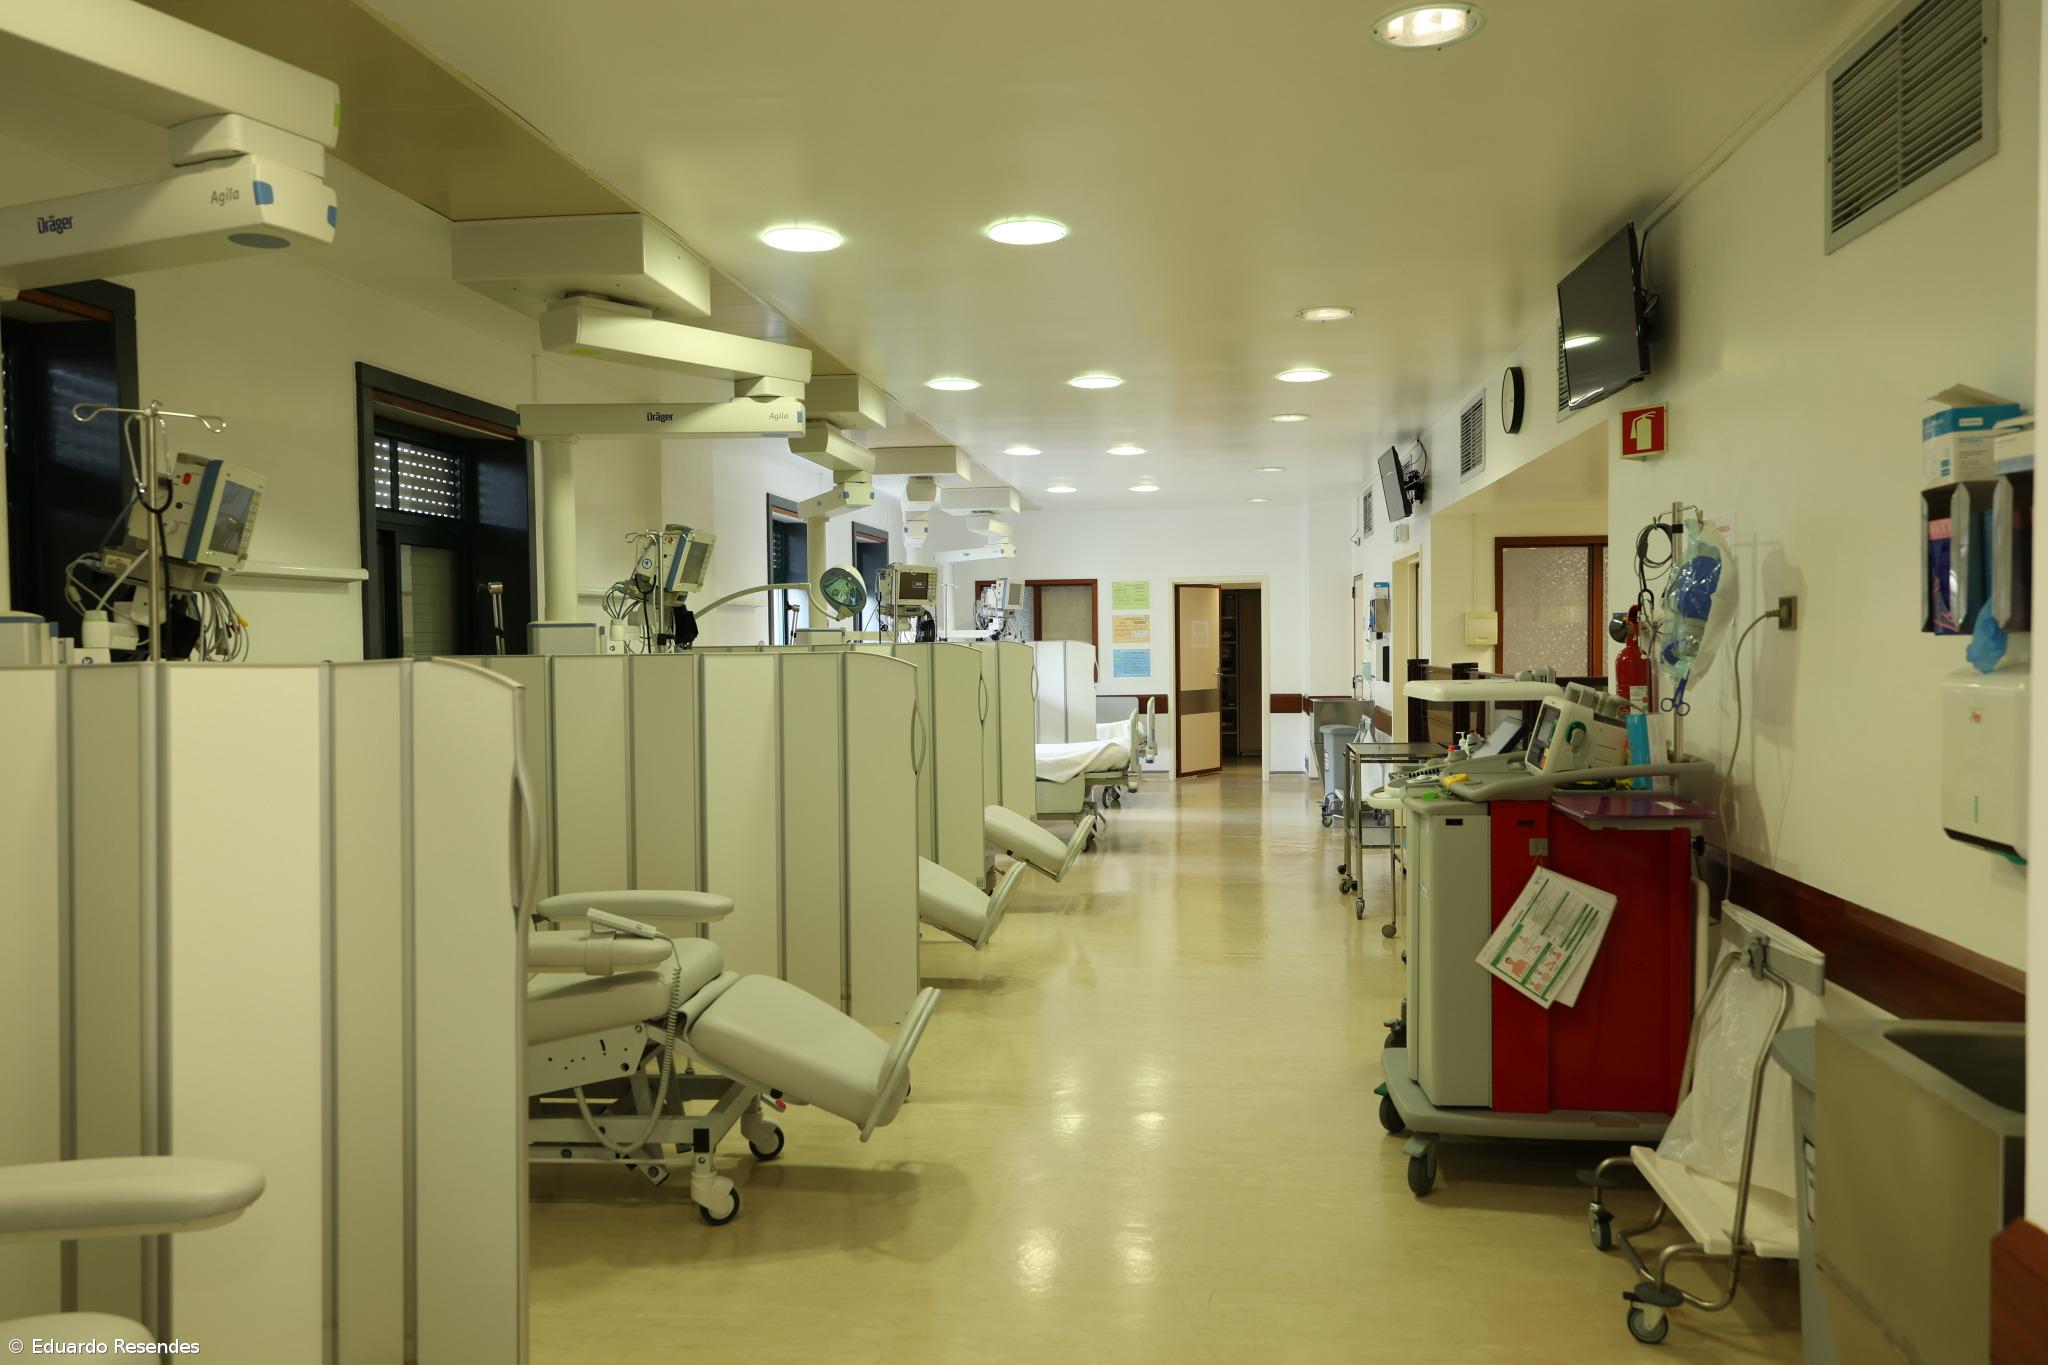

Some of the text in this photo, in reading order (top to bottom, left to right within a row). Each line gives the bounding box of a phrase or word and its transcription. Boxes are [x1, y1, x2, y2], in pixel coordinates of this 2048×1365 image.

[210, 188, 240, 206] Agila
[37, 215, 73, 234] Dräger
[646, 411, 673, 423] Dräger
[768, 412, 789, 421] Agila
